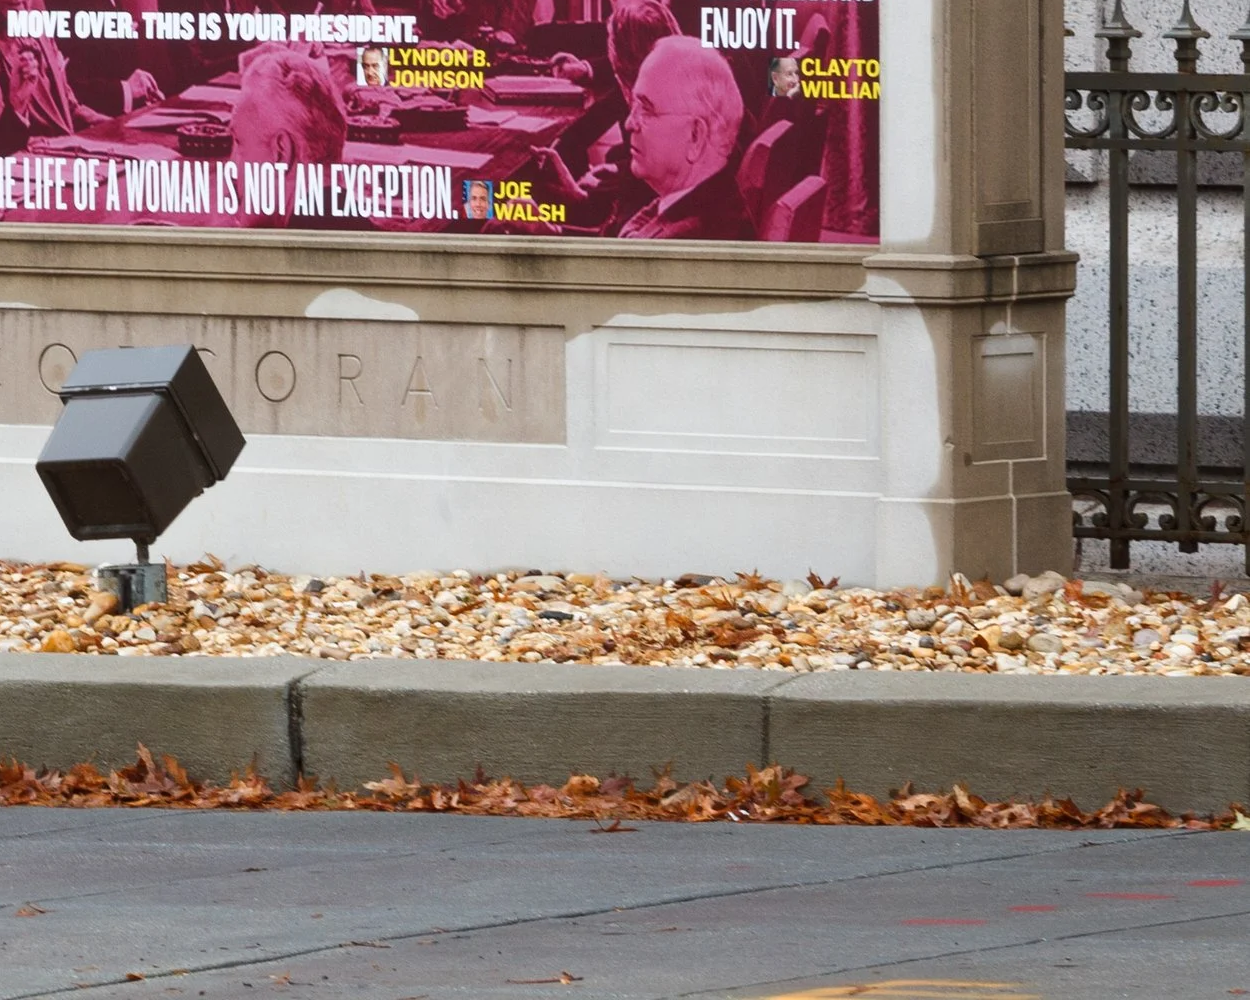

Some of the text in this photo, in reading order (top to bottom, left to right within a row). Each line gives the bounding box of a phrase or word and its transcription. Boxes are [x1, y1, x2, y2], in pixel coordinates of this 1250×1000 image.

[8, 11, 418, 42] MOVE OVER. THIS IS YOUR PRESIDENT.
[701, 8, 799, 49] ENJOY IT.
[389, 49, 490, 67] LYNDON B.
[392, 70, 483, 88] JOHNSON
[23, 157, 67, 209] LIFE
[73, 158, 99, 210] OF
[107, 159, 120, 211] A
[125, 160, 209, 212] WOMAN
[217, 162, 238, 214] IS
[245, 162, 287, 215] NOT
[295, 164, 323, 216] AN
[331, 164, 457, 218] EXCEPTION.
[495, 182, 531, 200] JOE
[494, 204, 565, 221] WALSH
